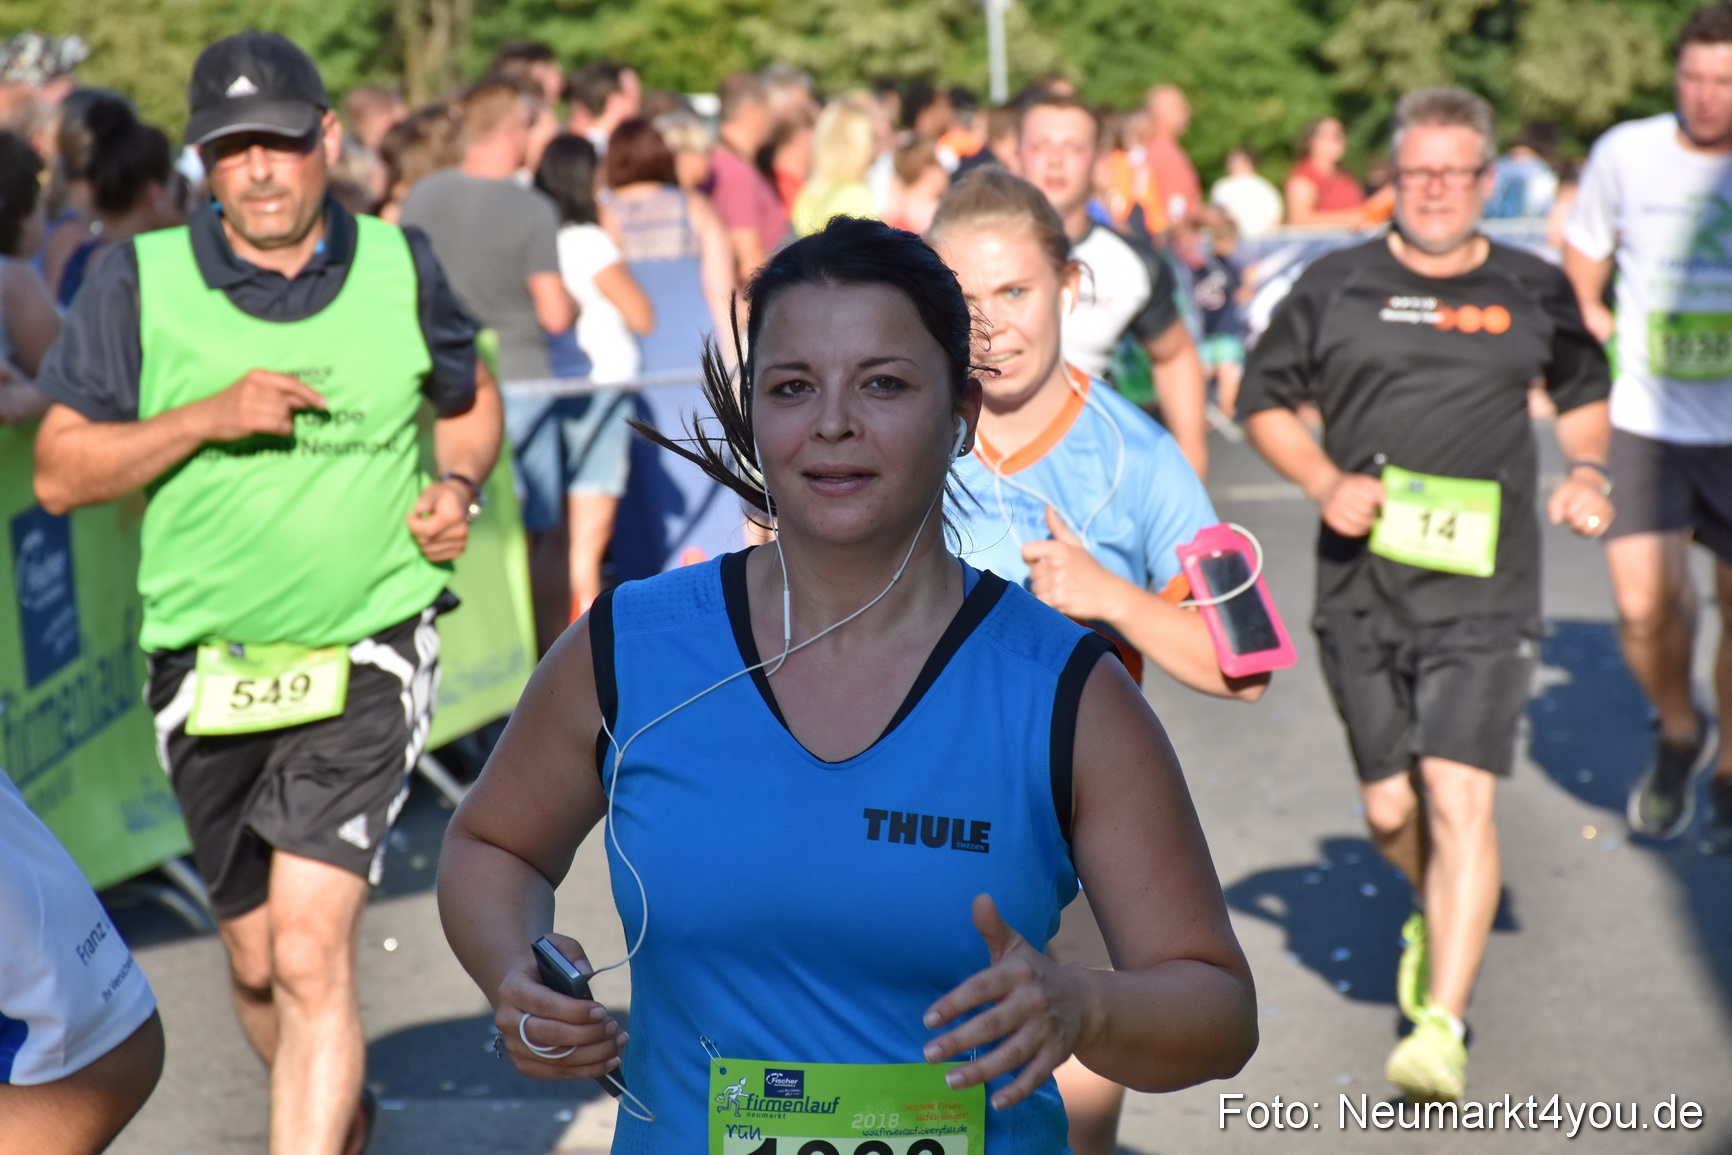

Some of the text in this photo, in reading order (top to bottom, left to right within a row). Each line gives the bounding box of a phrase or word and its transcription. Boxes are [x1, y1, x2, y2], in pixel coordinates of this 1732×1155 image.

[1420, 511, 1457, 541] 14
[230, 673, 311, 710] 549
[863, 808, 991, 849] THULE
[956, 842, 985, 851] SWEDEN
[75, 922, 107, 967] Franz
[771, 1076, 799, 1085] Fischer
[746, 1093, 841, 1114] firmenlauf
[851, 1113, 900, 1129] 2018
